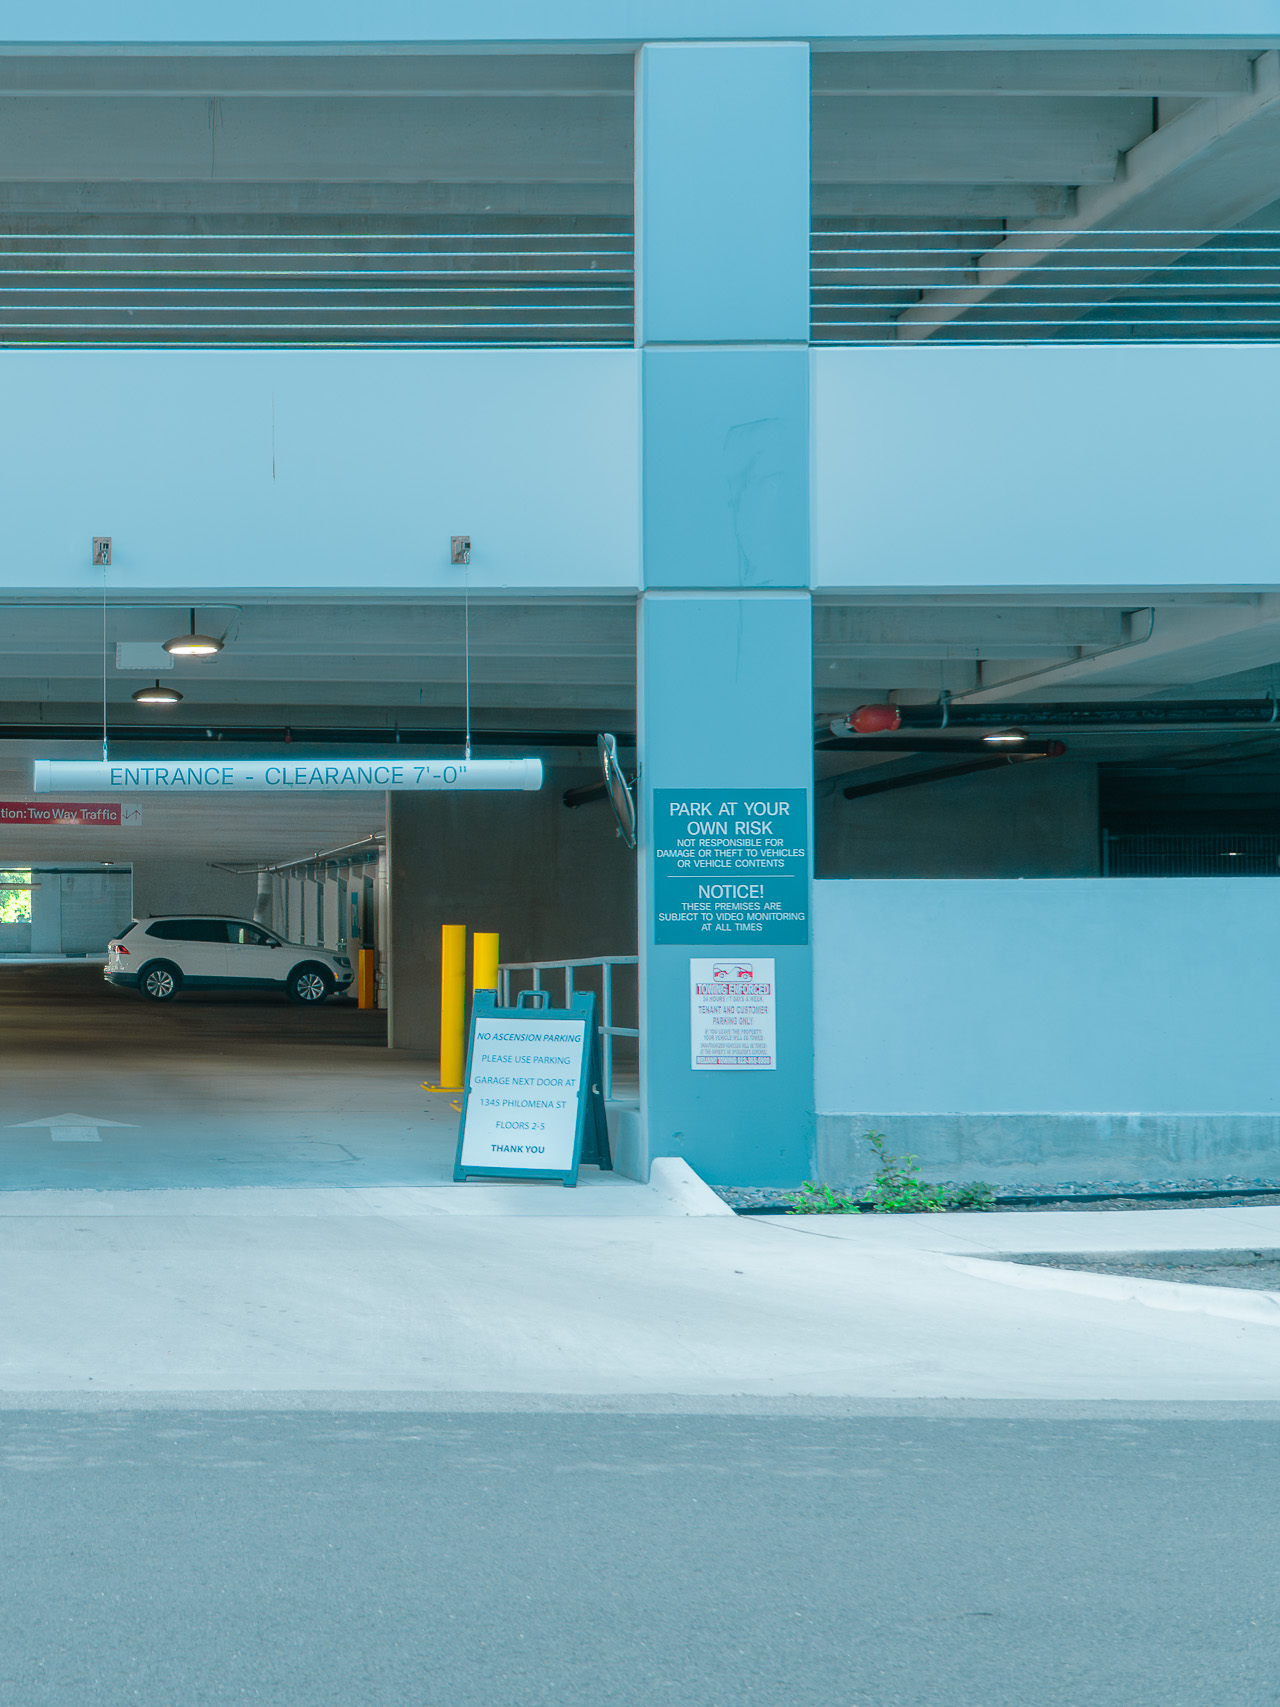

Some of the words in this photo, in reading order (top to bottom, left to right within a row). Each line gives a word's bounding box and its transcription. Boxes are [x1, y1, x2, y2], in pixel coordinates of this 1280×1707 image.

[110, 768, 234, 786] ENTRANCE
[265, 767, 403, 785] CLEARANCE
[413, 766, 468, 784] 7'-0"
[670, 802, 711, 816] PARK
[718, 802, 738, 816] AT
[744, 802, 790, 815] YOUR
[27, 808, 50, 819] Two
[52, 809, 77, 820] Way
[80, 809, 117, 820] Traffic
[687, 822, 727, 835] OWN
[735, 821, 773, 835] RISK
[714, 849, 743, 857] THEFT
[746, 849, 757, 857] TO
[677, 860, 690, 868] OR
[735, 859, 784, 867] CONTENTS
[698, 885, 763, 898] NOTICE!
[763, 902, 781, 910] ARE
[659, 913, 697, 921] SUBJECT
[700, 913, 713, 921] TO
[716, 913, 743, 921] VIDEO
[747, 912, 805, 920] MONITORING
[701, 923, 712, 931] AT
[715, 923, 731, 931] ALL
[735, 923, 762, 931] TIMES
[698, 984, 728, 995] TOWING
[729, 984, 770, 995] ENFORCED
[698, 1006, 721, 1014] TENANT
[723, 1006, 735, 1014] AND
[737, 1006, 768, 1014] CUSTOMER
[713, 1017, 738, 1025] PARKING
[739, 1017, 753, 1025] ONLY
[492, 1033, 542, 1042] ASCENSION
[543, 1034, 581, 1043] PARKING
[482, 1055, 512, 1063] PLEASE
[515, 1056, 531, 1064] USE
[533, 1056, 571, 1064] PARKING
[474, 1076, 510, 1085] GARAGE
[512, 1078, 535, 1086] NEXT
[502, 1100, 554, 1108] PHILOMENA
[496, 1121, 530, 1129] FLOORS
[531, 1122, 545, 1130] 2-5
[491, 1145, 523, 1153] THANK
